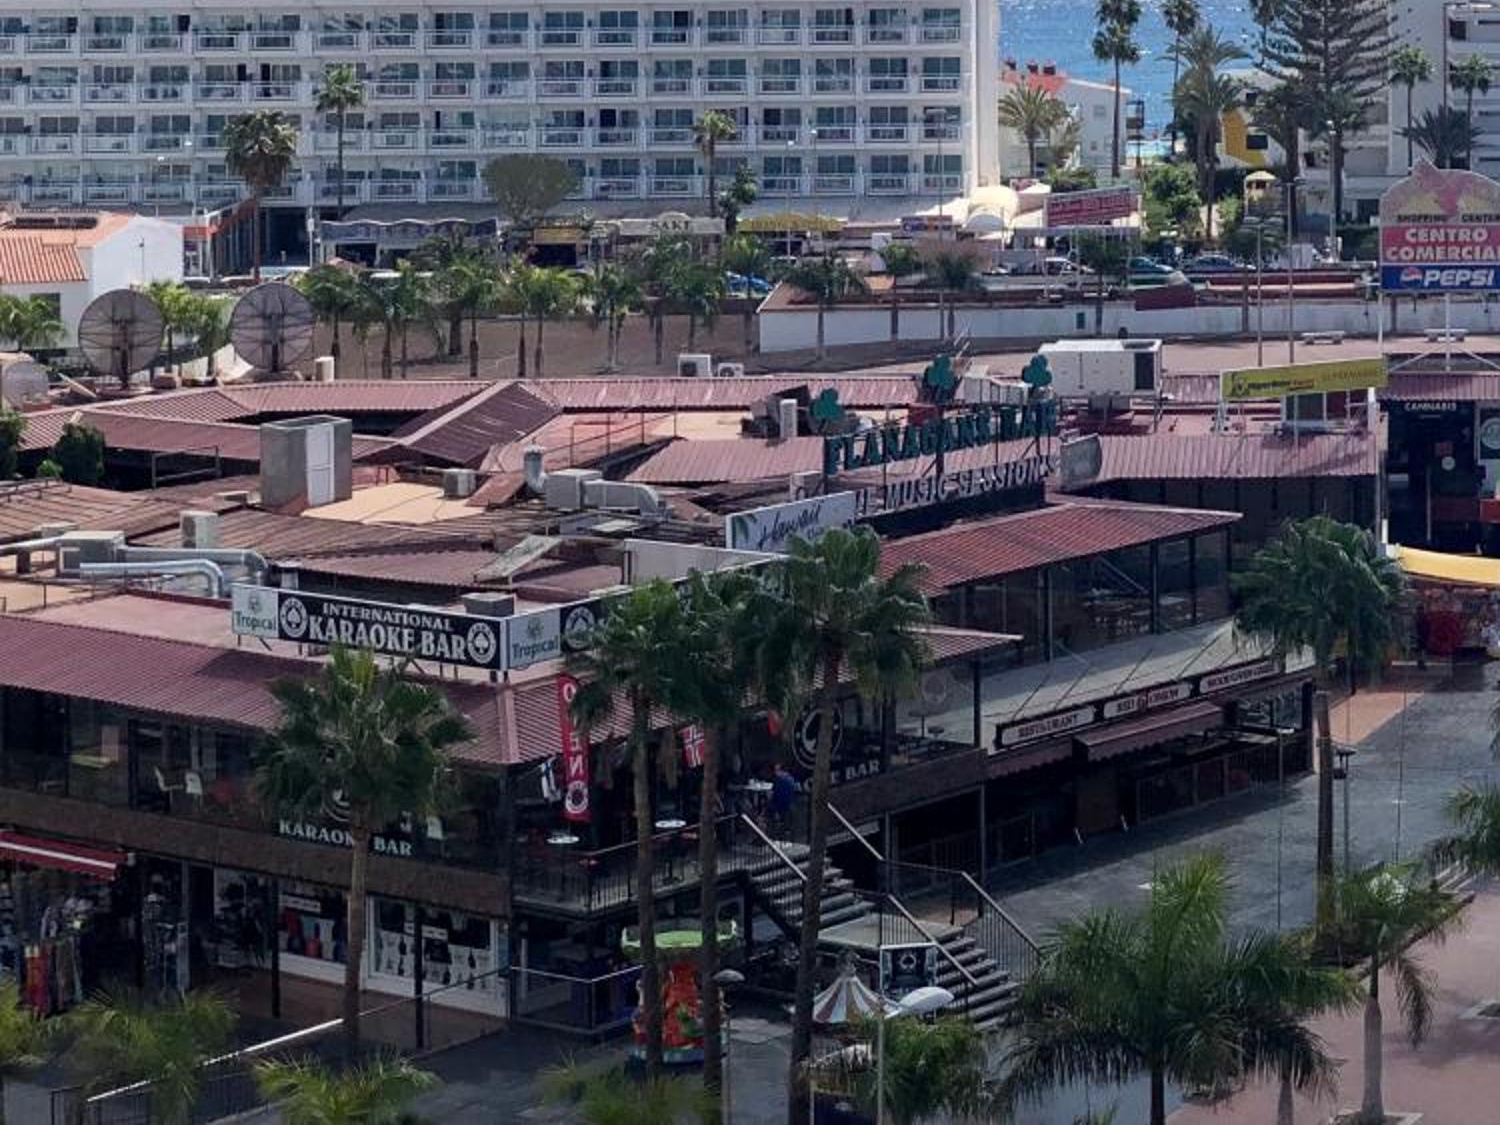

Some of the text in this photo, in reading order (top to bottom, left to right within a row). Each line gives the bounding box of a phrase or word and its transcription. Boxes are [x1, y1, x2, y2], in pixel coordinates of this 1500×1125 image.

[1405, 228, 1488, 243] CENTRO
[1423, 269, 1496, 286] PEPSI
[886, 472, 949, 510] MUSIC
[323, 602, 454, 631] INTERNATIONAL
[309, 615, 415, 652] KARAOKE
[421, 629, 467, 661] BAR
[512, 635, 559, 660] Tropical
[278, 818, 412, 856] KARAOK BAR
